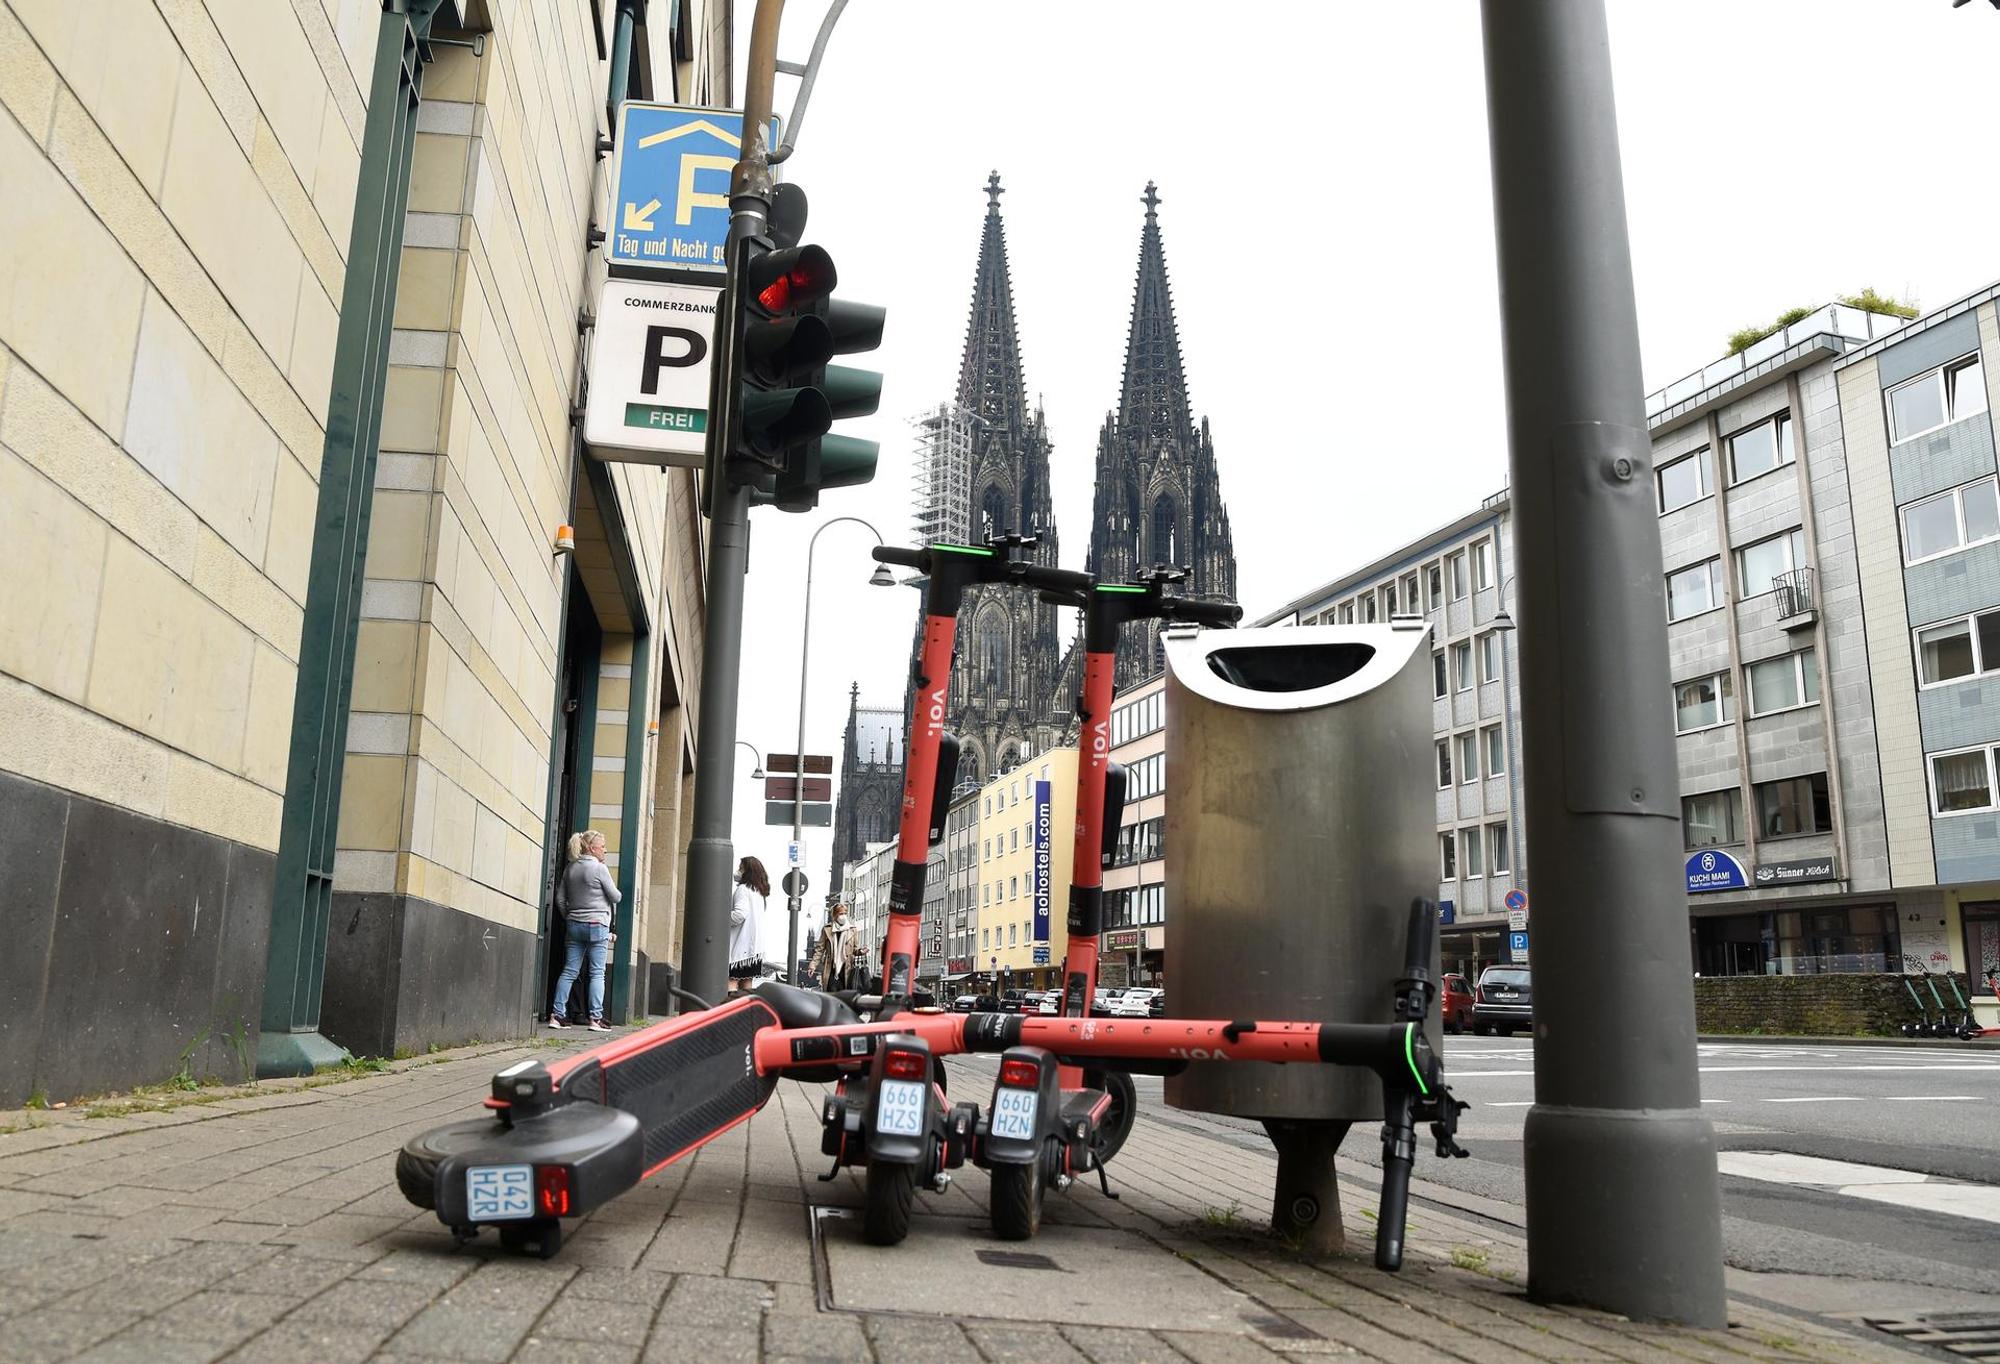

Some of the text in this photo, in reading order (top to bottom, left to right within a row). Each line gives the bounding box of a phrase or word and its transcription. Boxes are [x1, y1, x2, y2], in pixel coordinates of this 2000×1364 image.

[675, 153, 740, 226] P
[618, 234, 638, 257] Tag
[644, 238, 666, 255] und
[672, 238, 708, 259] Nacht
[624, 297, 716, 314] COMMERZBANK
[640, 324, 708, 395] P
[649, 411, 694, 428] FREI
[1035, 803, 1050, 916] aohostels.com
[1689, 871, 1730, 883] KUCHI MAMI
[886, 1086, 919, 1106] 666
[1001, 1093, 1032, 1113] 660
[882, 1109, 918, 1131] HZS
[996, 1113, 1030, 1134] HZN
[473, 1171, 498, 1214] HZR
[503, 1171, 528, 1210] 042
